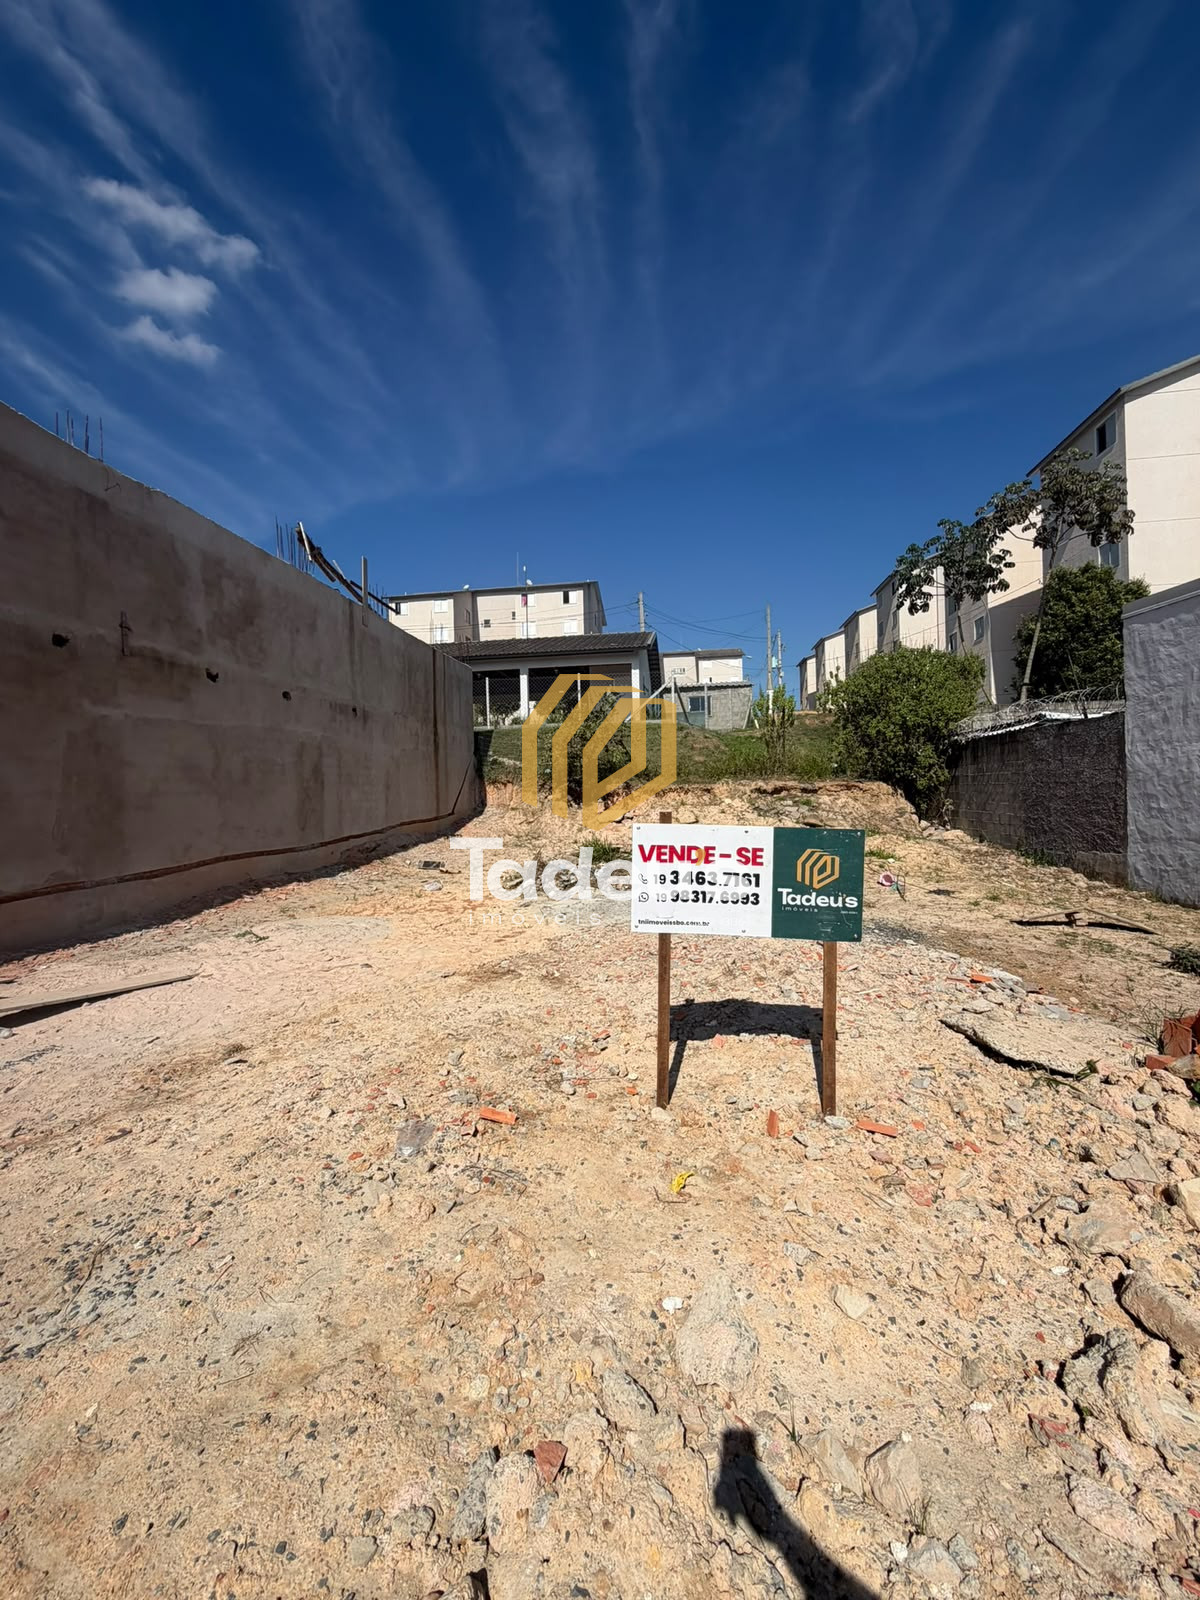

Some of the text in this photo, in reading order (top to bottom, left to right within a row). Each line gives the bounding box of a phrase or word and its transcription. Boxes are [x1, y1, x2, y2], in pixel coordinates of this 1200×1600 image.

[653, 870, 760, 888] 19 3463.7161
[655, 890, 760, 905] 19 98317.6993
